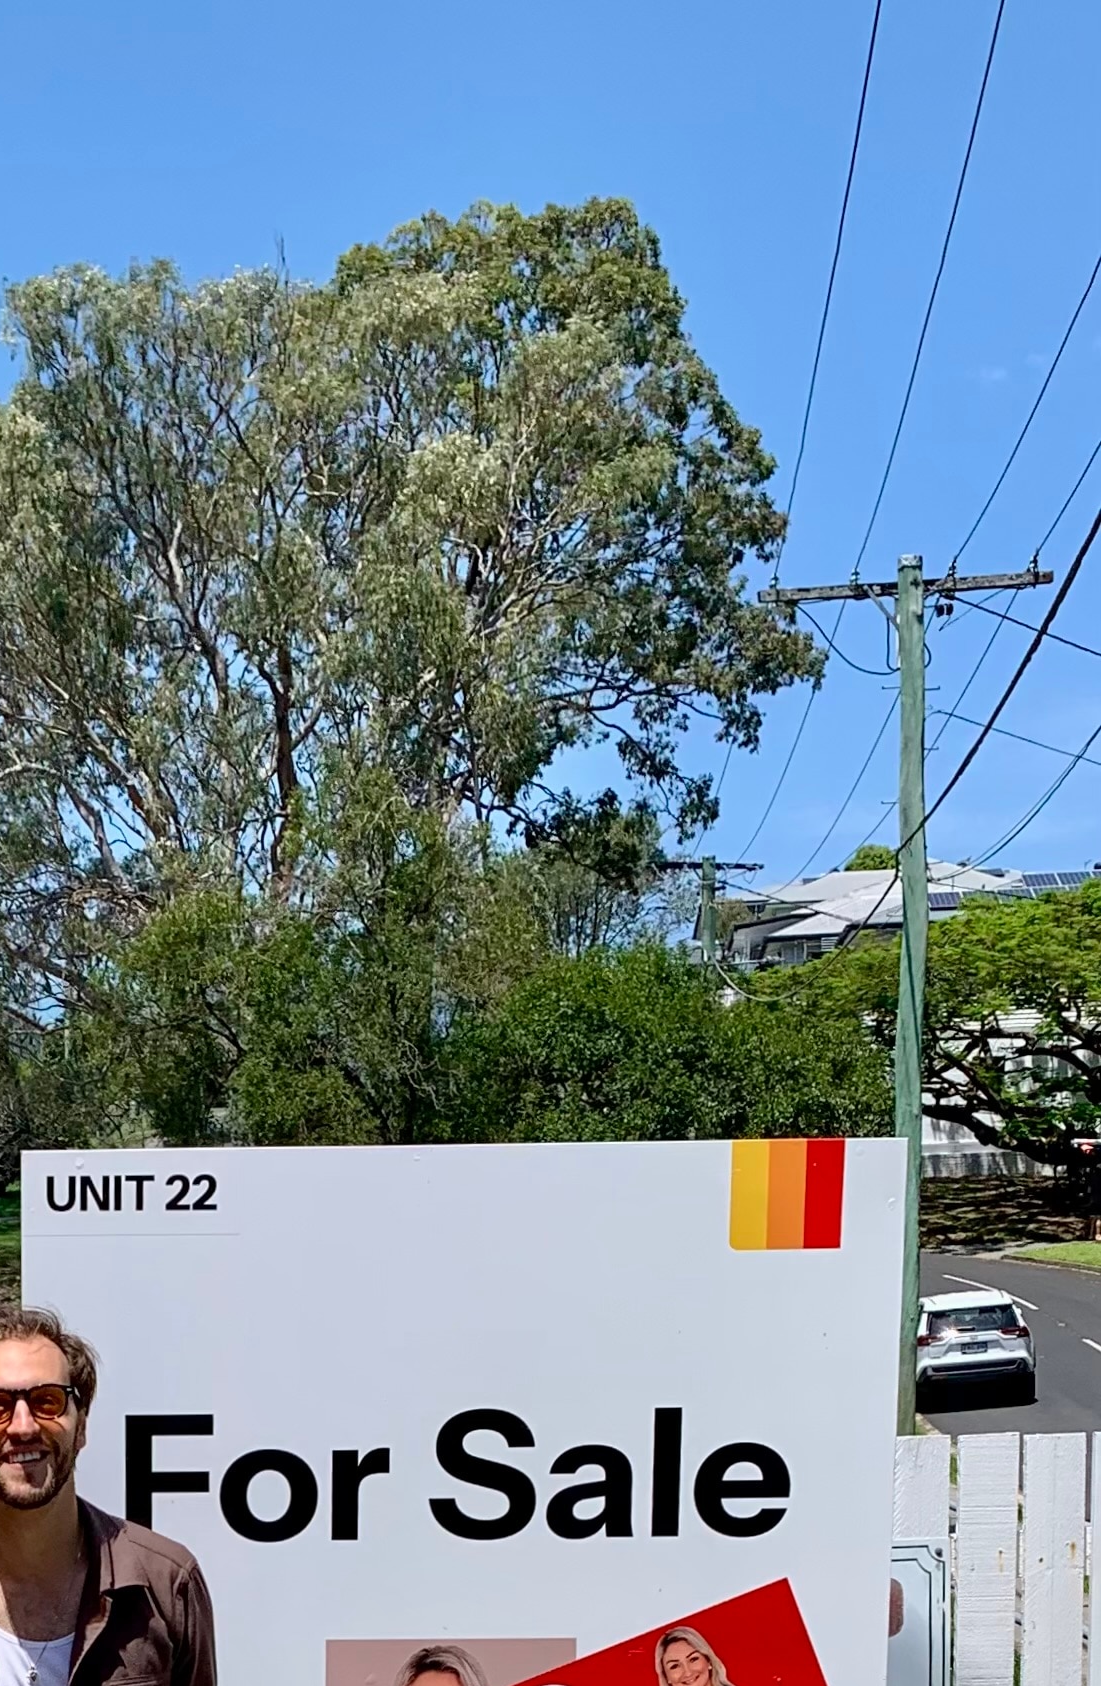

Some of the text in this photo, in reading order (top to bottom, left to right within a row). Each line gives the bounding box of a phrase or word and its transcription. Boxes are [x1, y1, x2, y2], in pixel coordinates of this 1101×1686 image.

[46, 1174, 218, 1212] UNIT 22
[125, 1407, 791, 1543] For Sale
